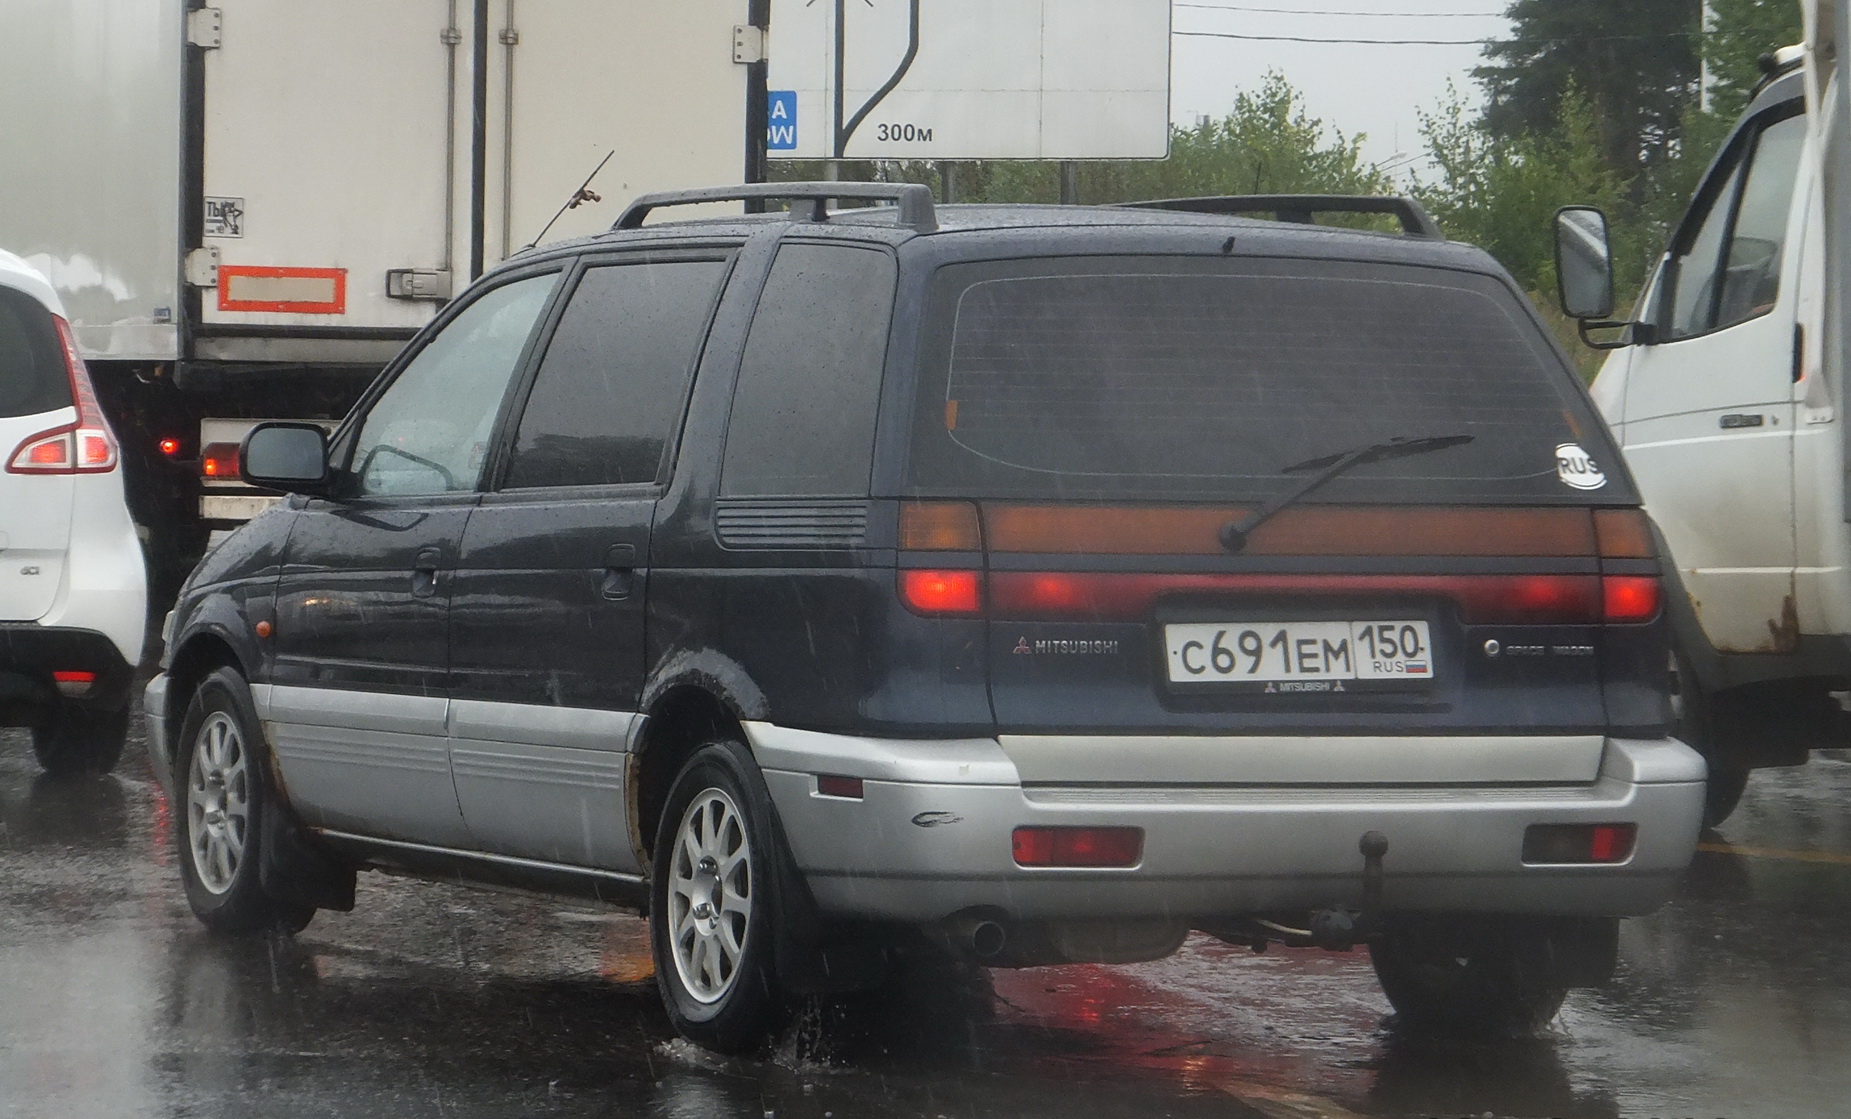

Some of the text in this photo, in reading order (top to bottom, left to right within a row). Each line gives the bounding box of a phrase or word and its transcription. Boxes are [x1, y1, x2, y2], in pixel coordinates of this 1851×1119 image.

[877, 123, 932, 142] 300м
[1557, 457, 1599, 475] RUS
[1035, 640, 1119, 654] MITSUBISHI
[1181, 625, 1420, 674] С691ЕМ 150
[1373, 661, 1405, 673] RUS
[1279, 682, 1331, 692] MITSUBISHI
